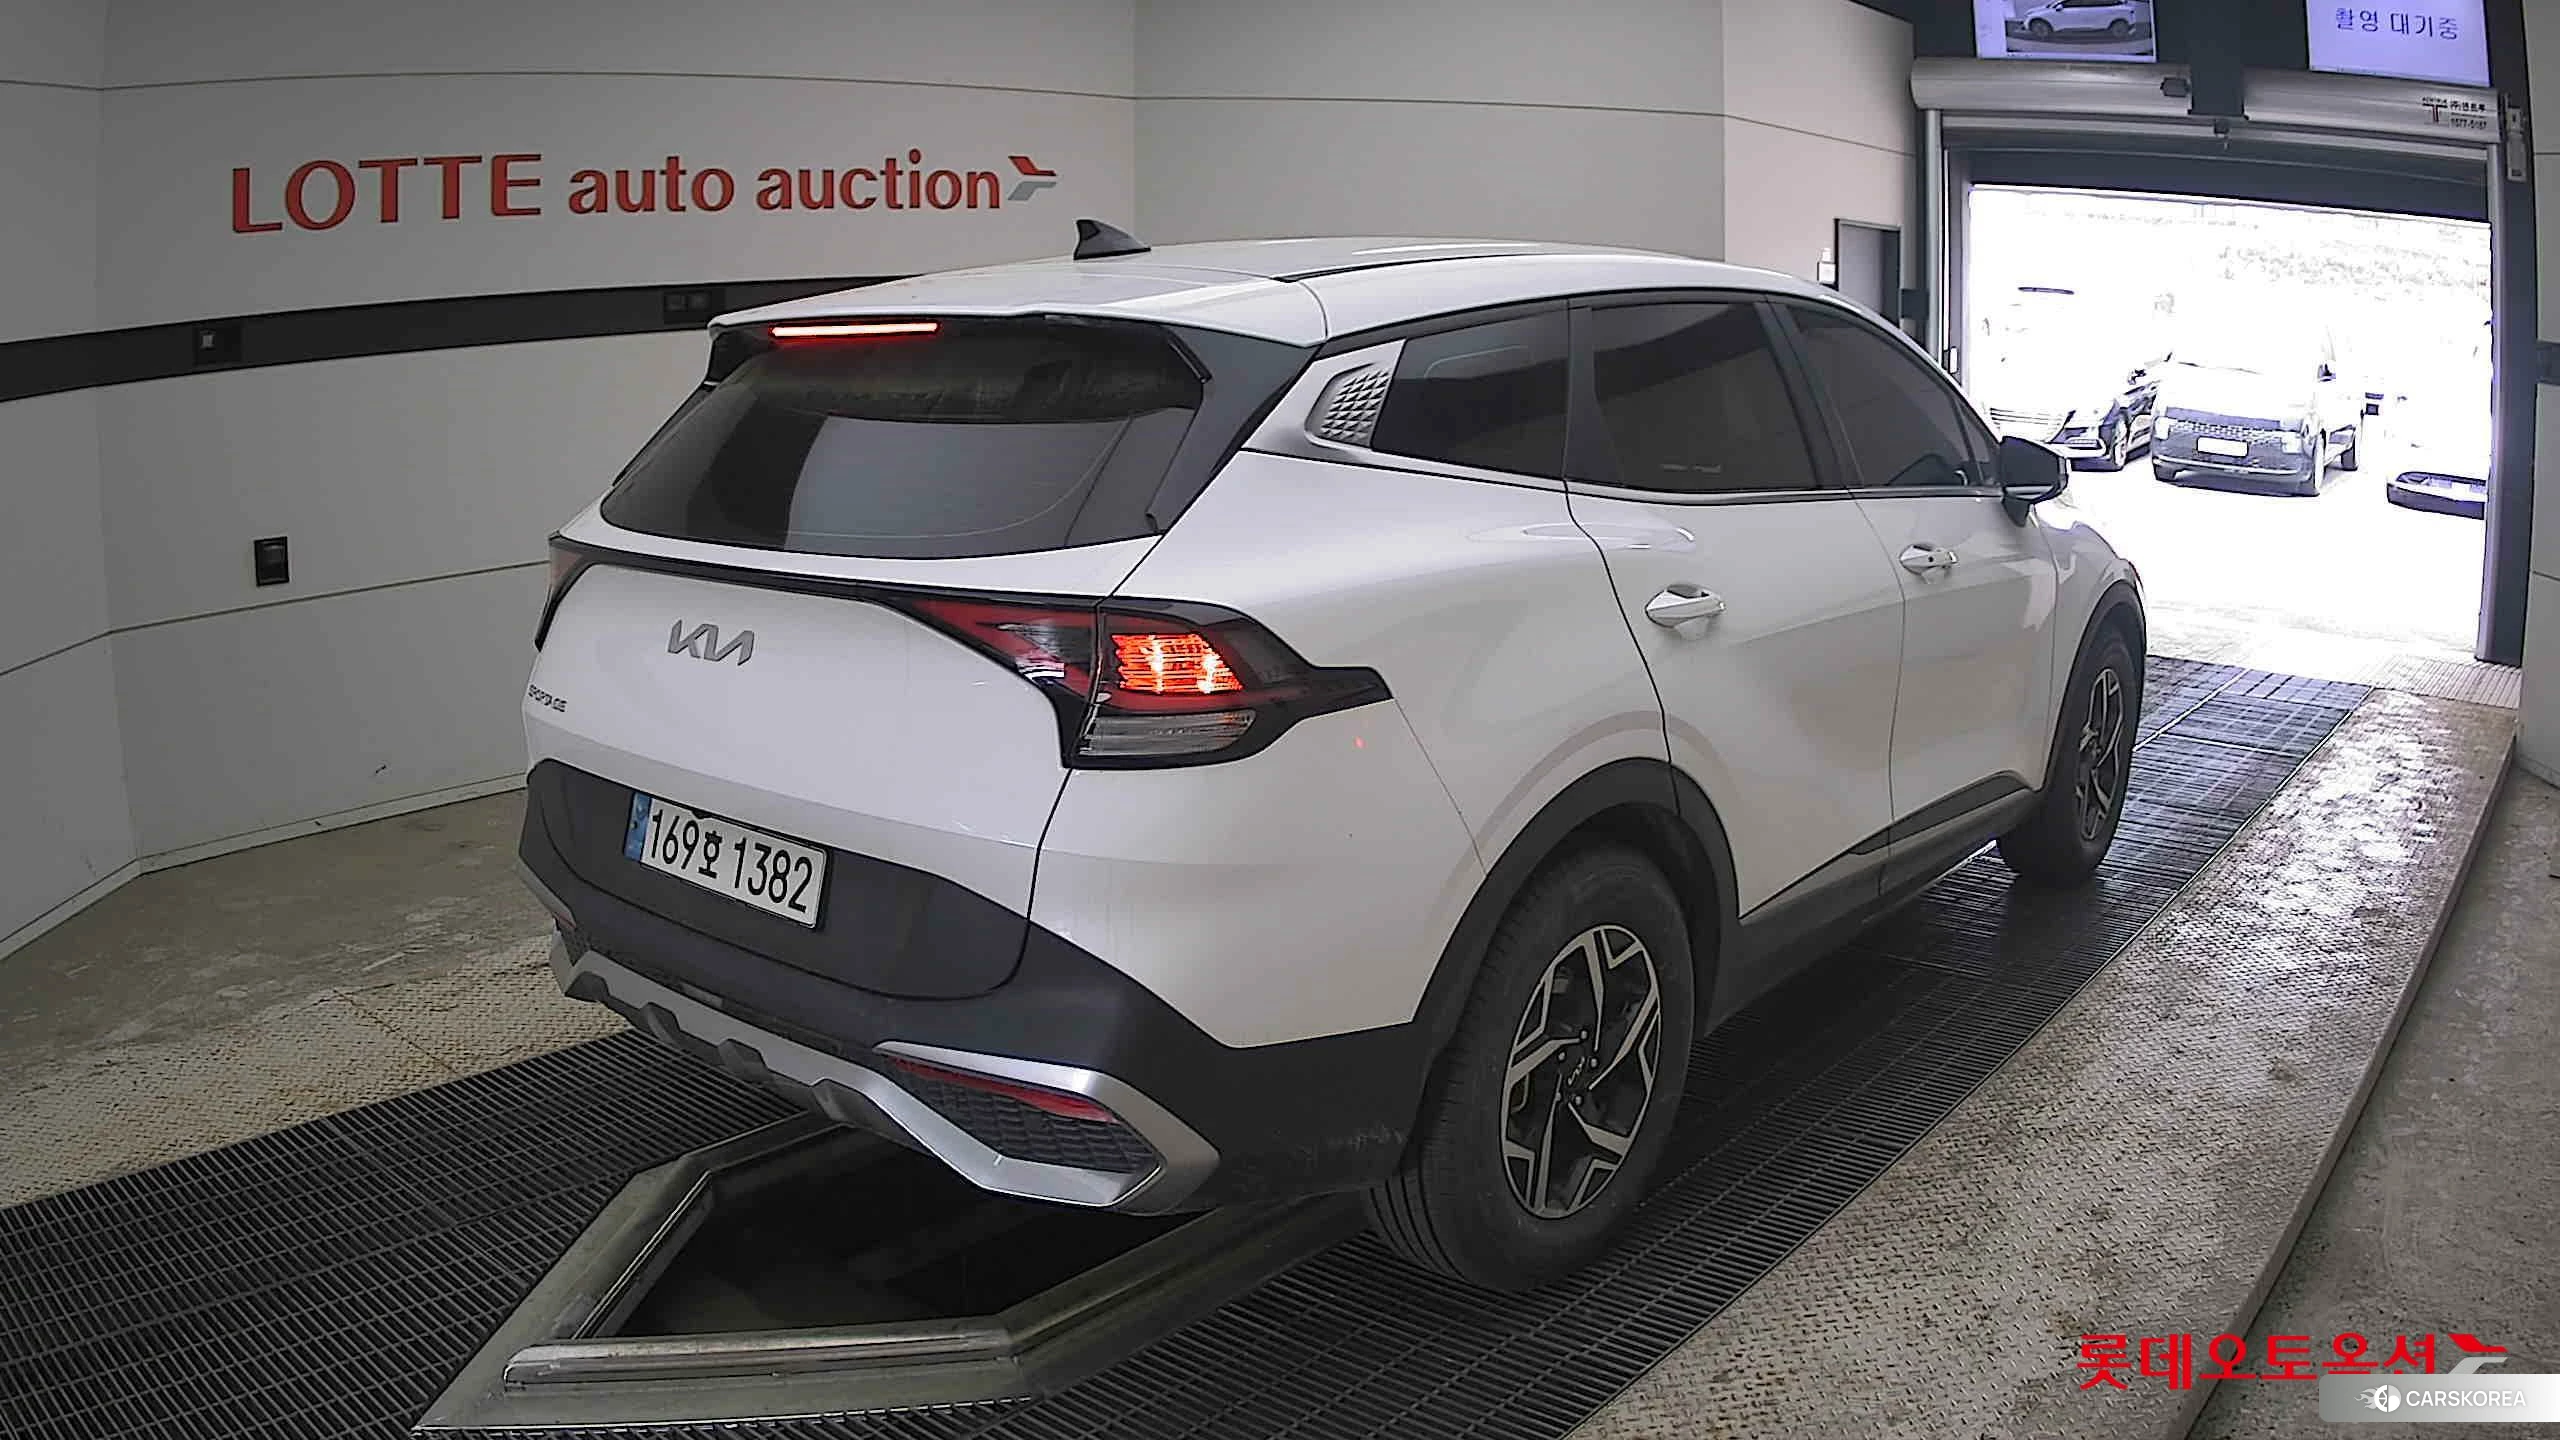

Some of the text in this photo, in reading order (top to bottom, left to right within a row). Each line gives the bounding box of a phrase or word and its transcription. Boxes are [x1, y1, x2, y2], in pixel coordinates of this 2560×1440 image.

[2390, 12, 2459, 41] 대기중
[232, 148, 1001, 234] LOTTE auto auction
[667, 619, 755, 666] KIA
[733, 836, 813, 914] 1382
